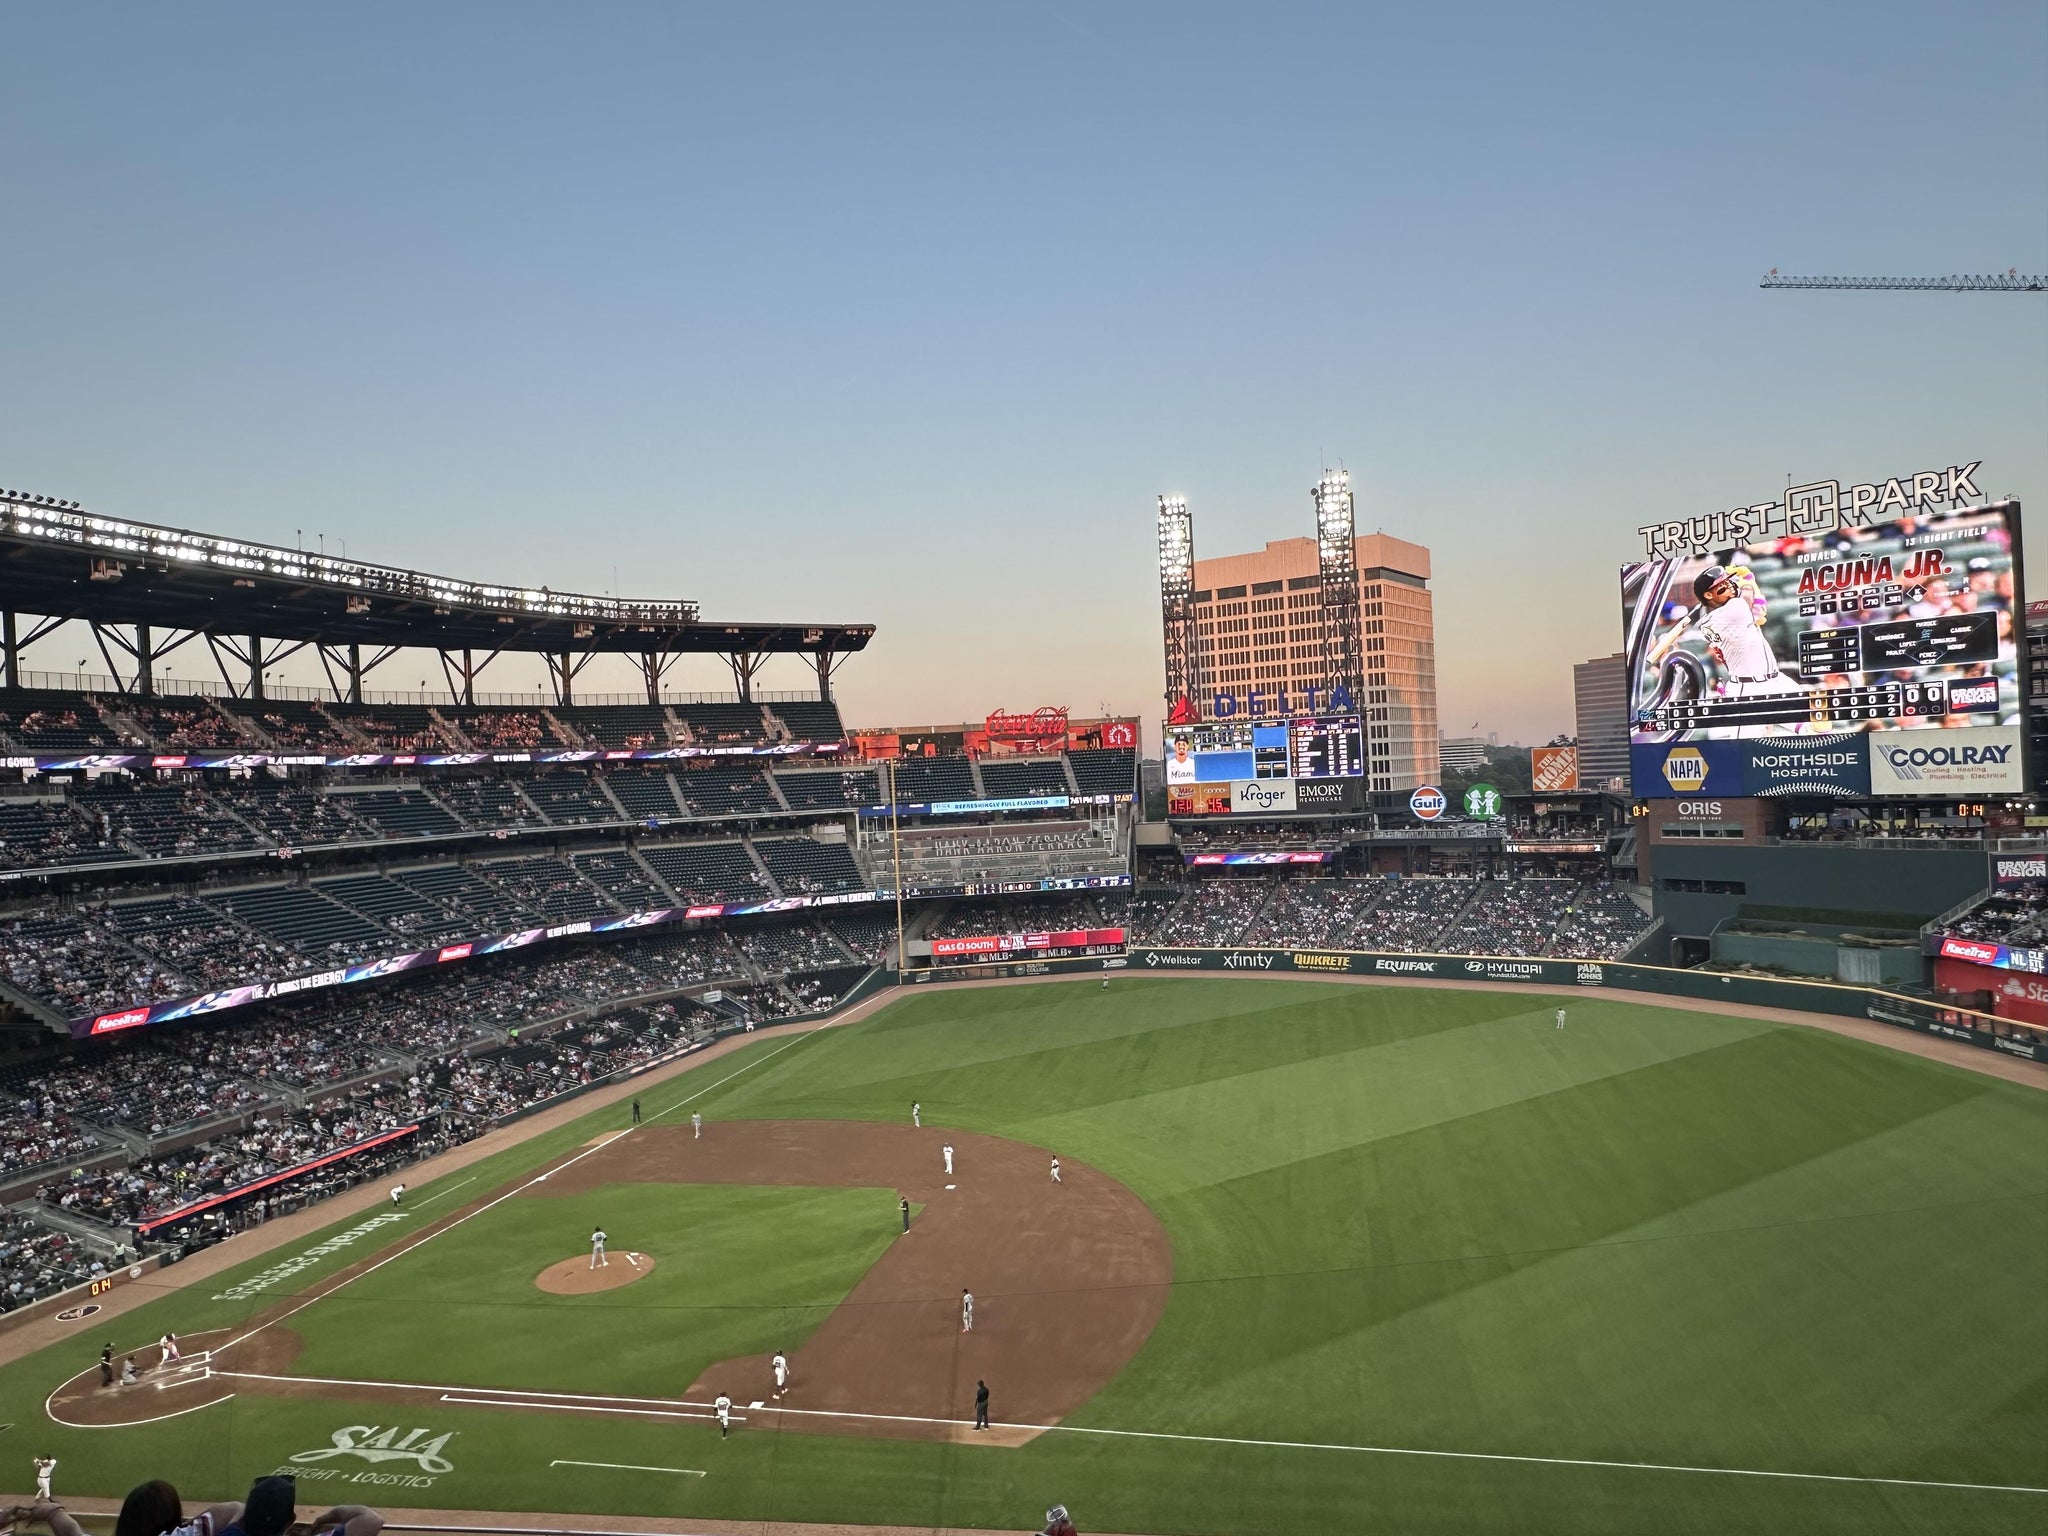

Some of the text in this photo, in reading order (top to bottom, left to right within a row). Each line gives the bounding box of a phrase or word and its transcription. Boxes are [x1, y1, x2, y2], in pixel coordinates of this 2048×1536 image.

[1638, 461, 1983, 554] TRUIST PARK
[1924, 532, 1955, 544] RIGHT
[1958, 527, 1987, 539] FIELD
[1798, 549, 1952, 593] ACUÑA JR.
[1214, 685, 1355, 717] DELTA
[1888, 695, 1895, 703] 2
[1906, 687, 1940, 702] 0 0
[1888, 708, 1895, 716] 2
[985, 706, 1070, 737] Coca-Cola
[1537, 753, 1555, 769] THE
[1753, 752, 1858, 768] NORTHSIDE
[1889, 745, 2012, 767] COOLRAY
[1533, 748, 1576, 789] HOME
[1670, 760, 1701, 779] NAPA
[1771, 767, 1838, 778] HOSPITAL
[1550, 764, 1577, 789] DEPOT
[1241, 784, 1285, 808] Kroger
[1299, 785, 1343, 796] EMORY
[1412, 798, 1443, 808] Gulf
[1678, 802, 1722, 815] ORIS
[1959, 804, 1983, 816] 0:14
[935, 832, 1092, 857] HANK AARON TERRACE
[1997, 861, 2046, 870] BRAVES
[1998, 867, 2046, 877] VISION
[938, 941, 993, 952] GAS SOUTH
[999, 939, 1011, 948] AL
[1097, 945, 1121, 954] MLB+
[989, 952, 1013, 961] MLB+
[1047, 948, 1072, 957] MLB+
[1946, 943, 1991, 959] RaceTrac
[1161, 955, 1202, 965] Wellstar
[1223, 952, 1273, 969] xfinity
[1294, 954, 1350, 966] QUIKRETE
[1376, 960, 1435, 972] EQUIFAX
[2010, 953, 2027, 966] NL
[1487, 963, 1542, 974] HYUNDAI
[1577, 964, 1602, 973] PAPA
[312, 969, 346, 988] ENERGY
[98, 1014, 145, 1030] RaceTrac
[289, 1425, 454, 1473] SAIA
[270, 1466, 437, 1488] FREIGHT LOGISTICS
